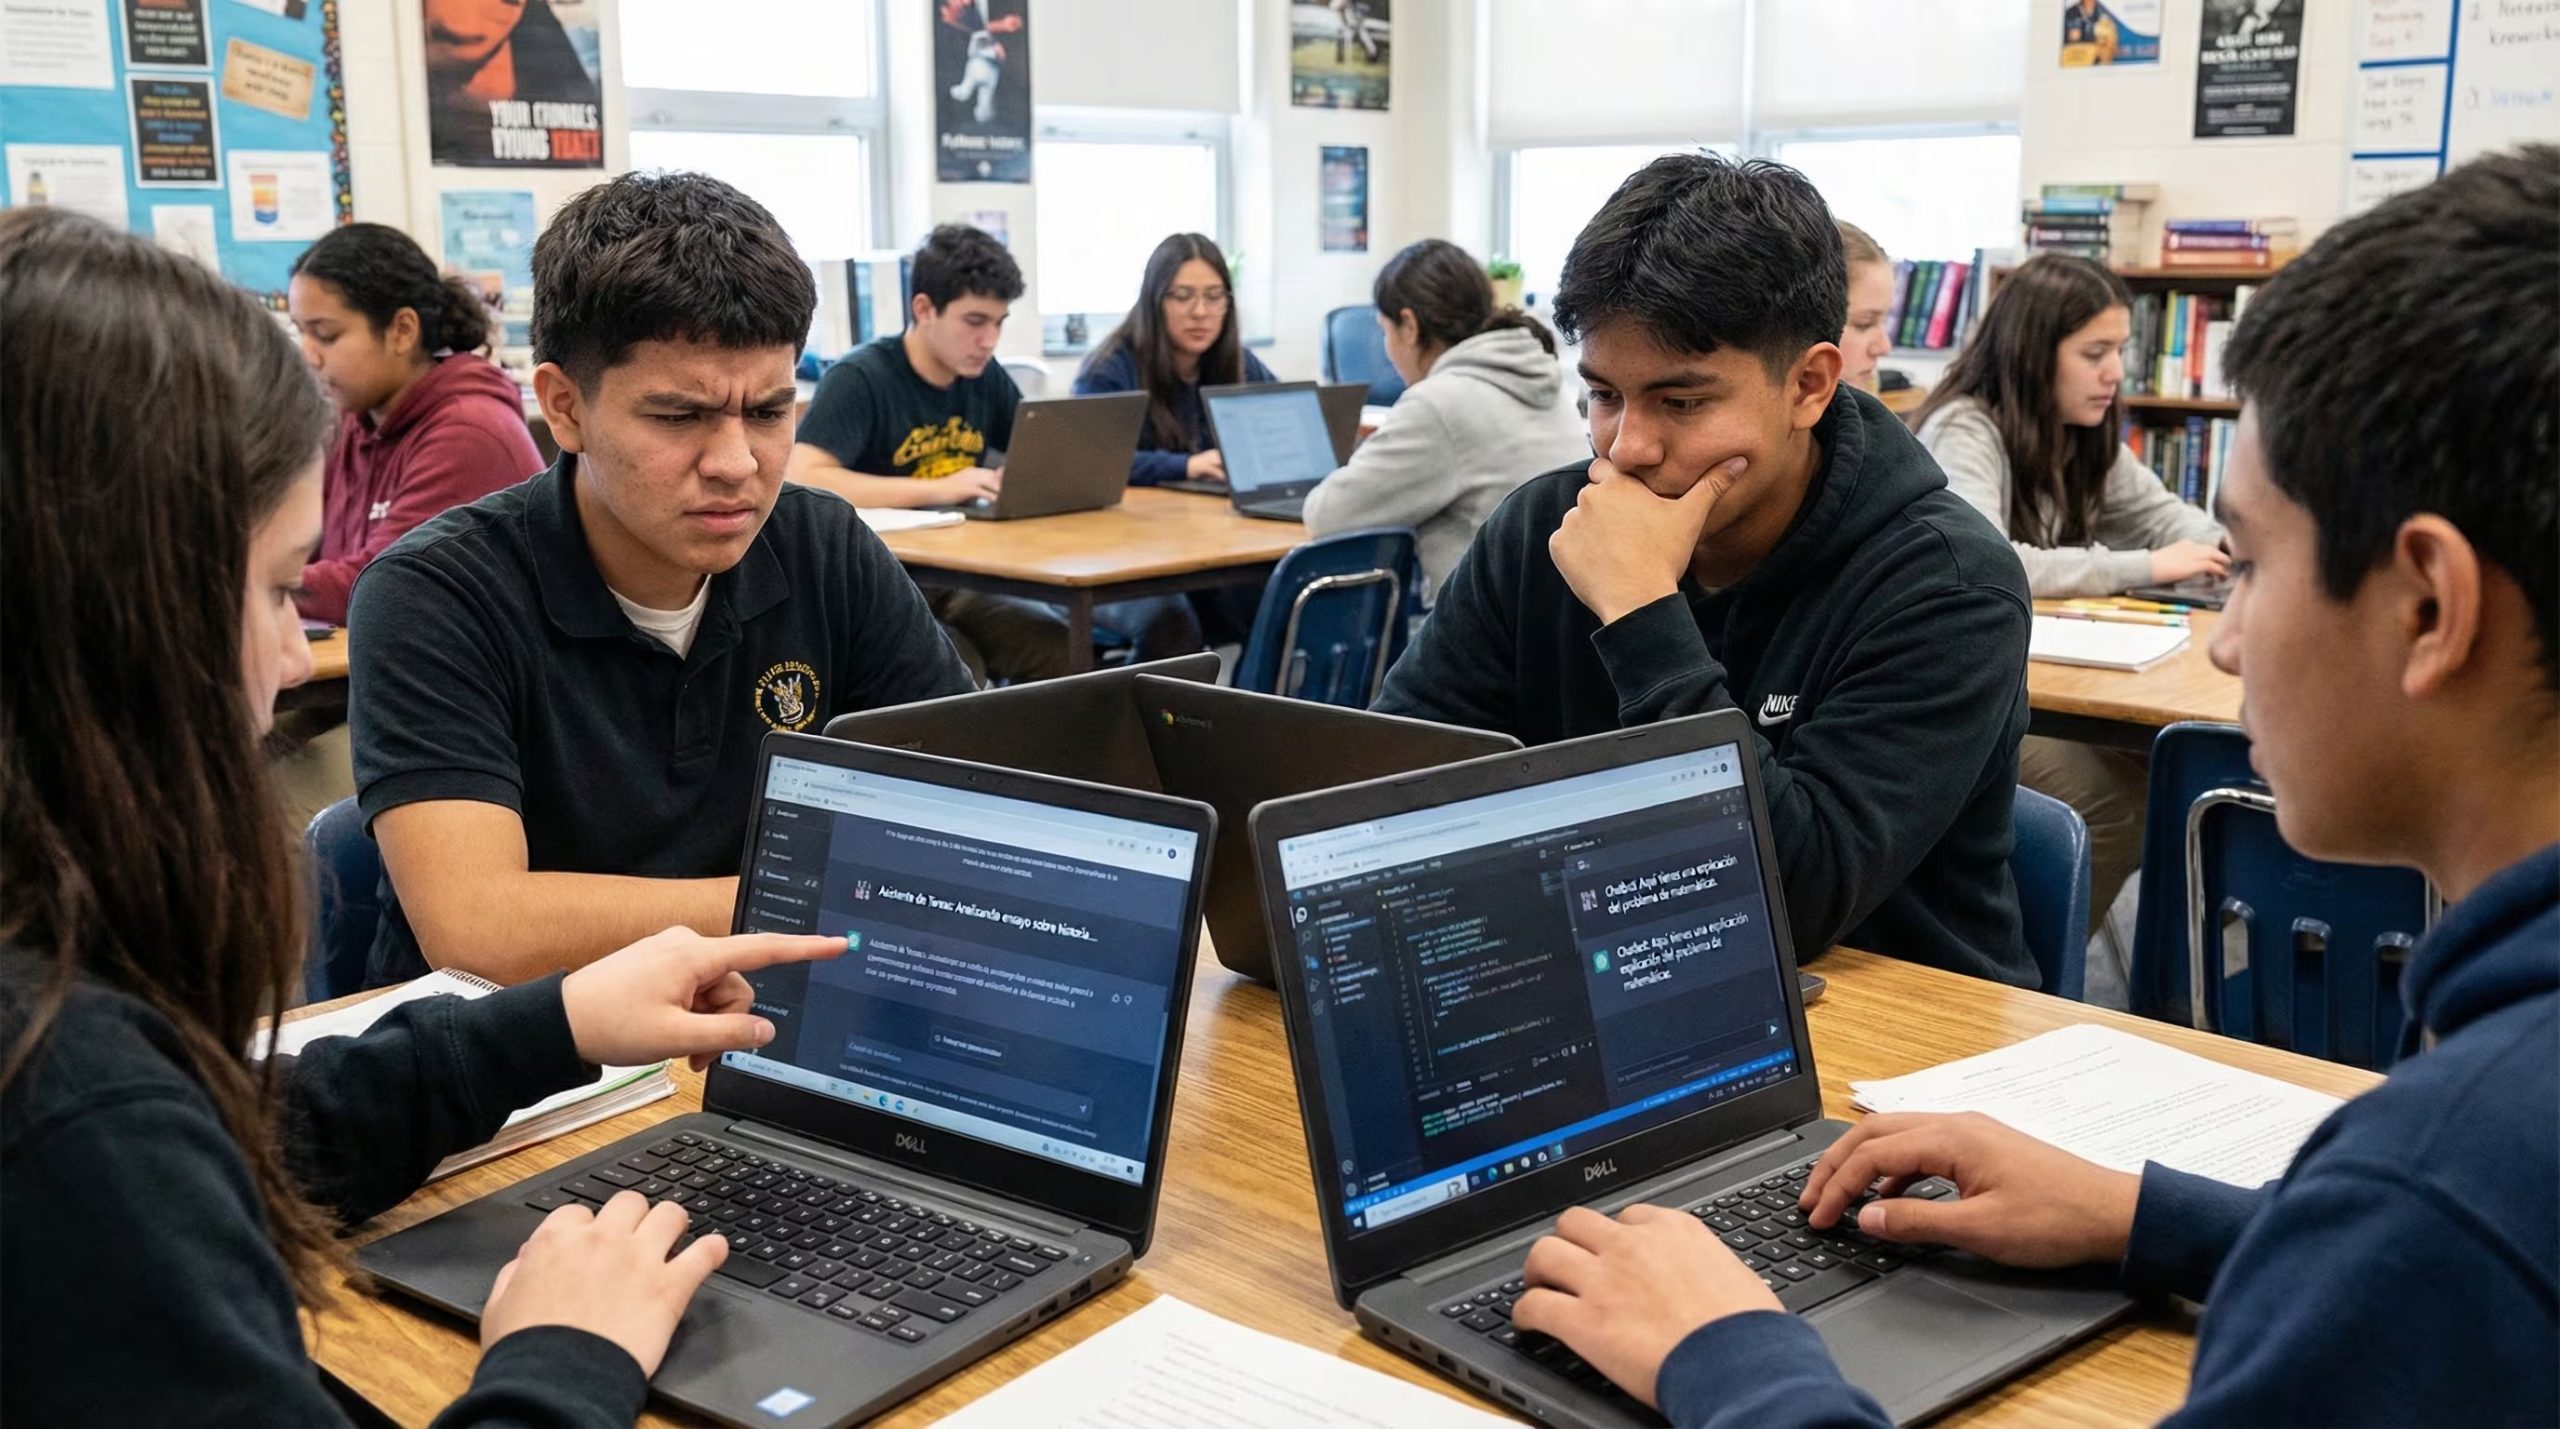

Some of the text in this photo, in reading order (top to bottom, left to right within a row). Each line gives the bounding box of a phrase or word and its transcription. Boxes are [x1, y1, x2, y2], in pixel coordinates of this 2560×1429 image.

[1765, 693, 1799, 713] NIKE
[895, 1132, 927, 1154] DELL
[1583, 1157, 1618, 1183] DELL
